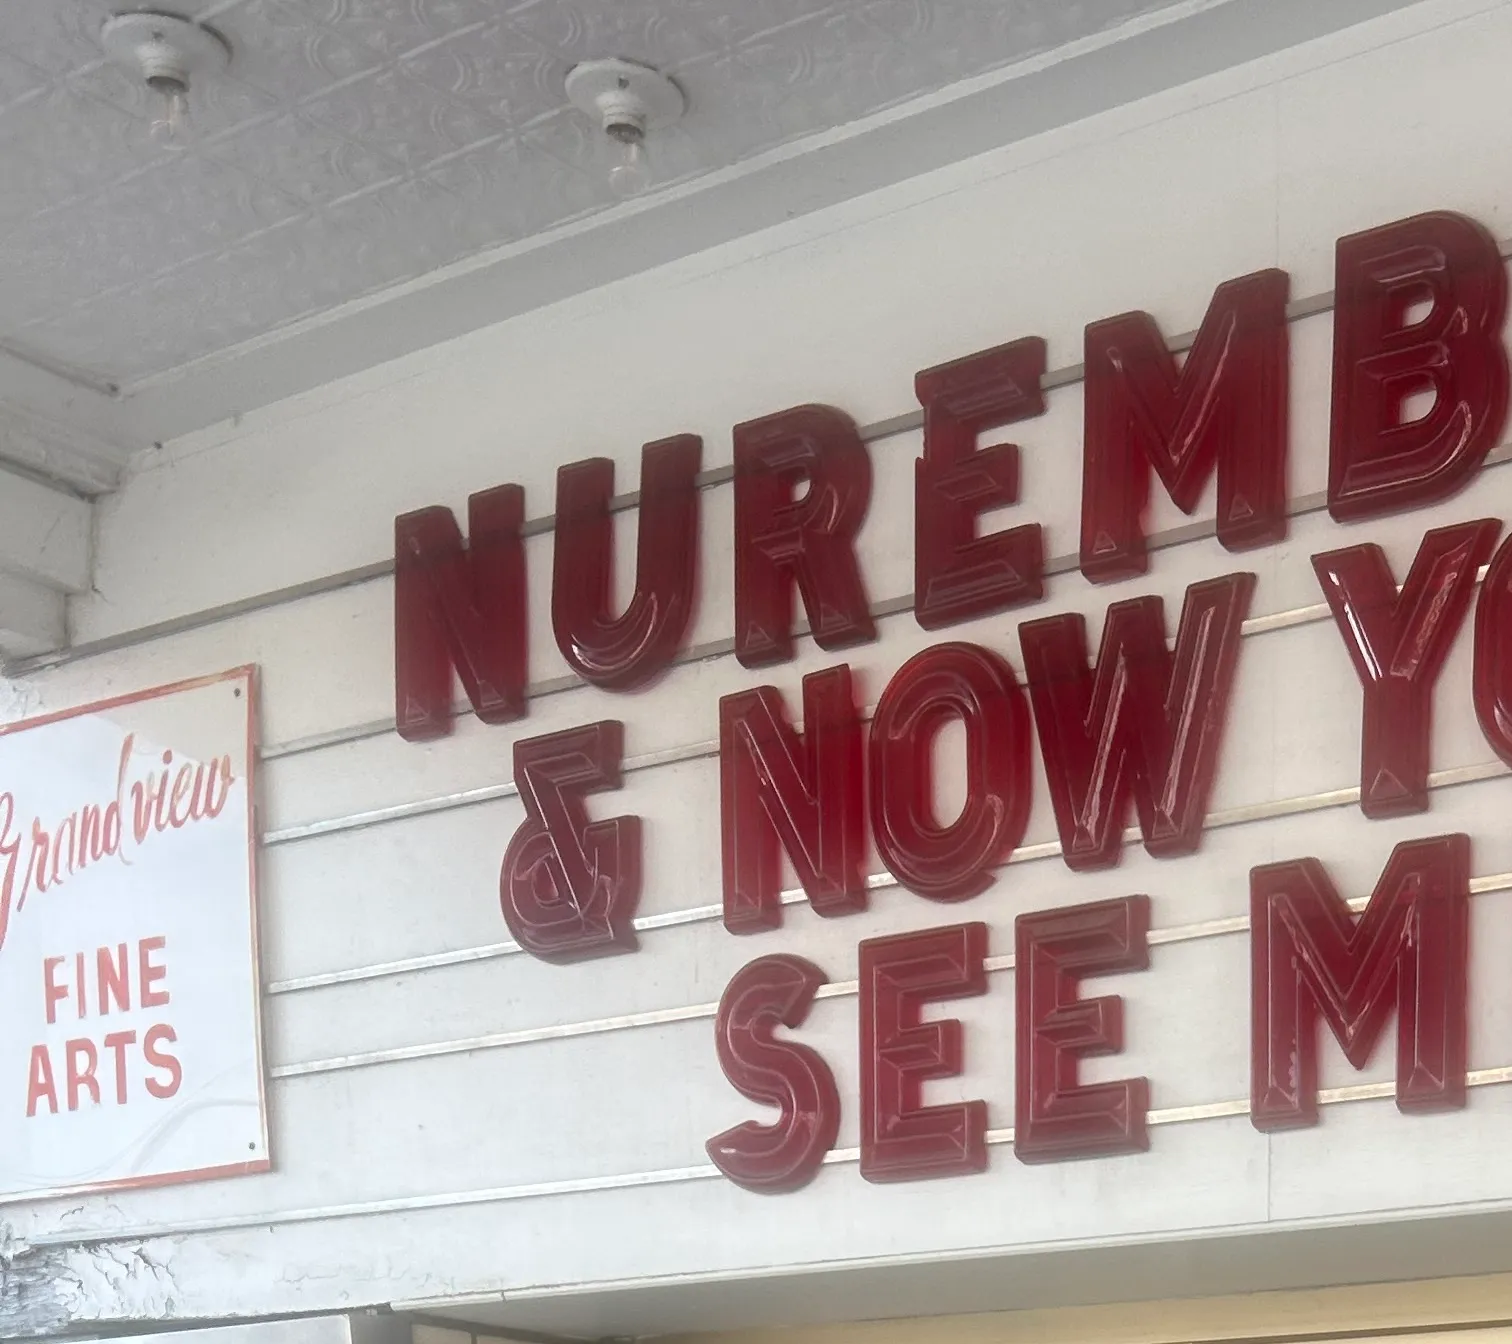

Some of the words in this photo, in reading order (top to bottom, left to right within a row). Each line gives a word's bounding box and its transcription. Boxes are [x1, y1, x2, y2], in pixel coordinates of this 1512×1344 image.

[500, 719, 642, 962] &
[722, 570, 1256, 938] NOW
[26, 1024, 182, 1117] ARTS
[44, 936, 170, 1024] FINE
[706, 894, 1150, 1194] SEE
